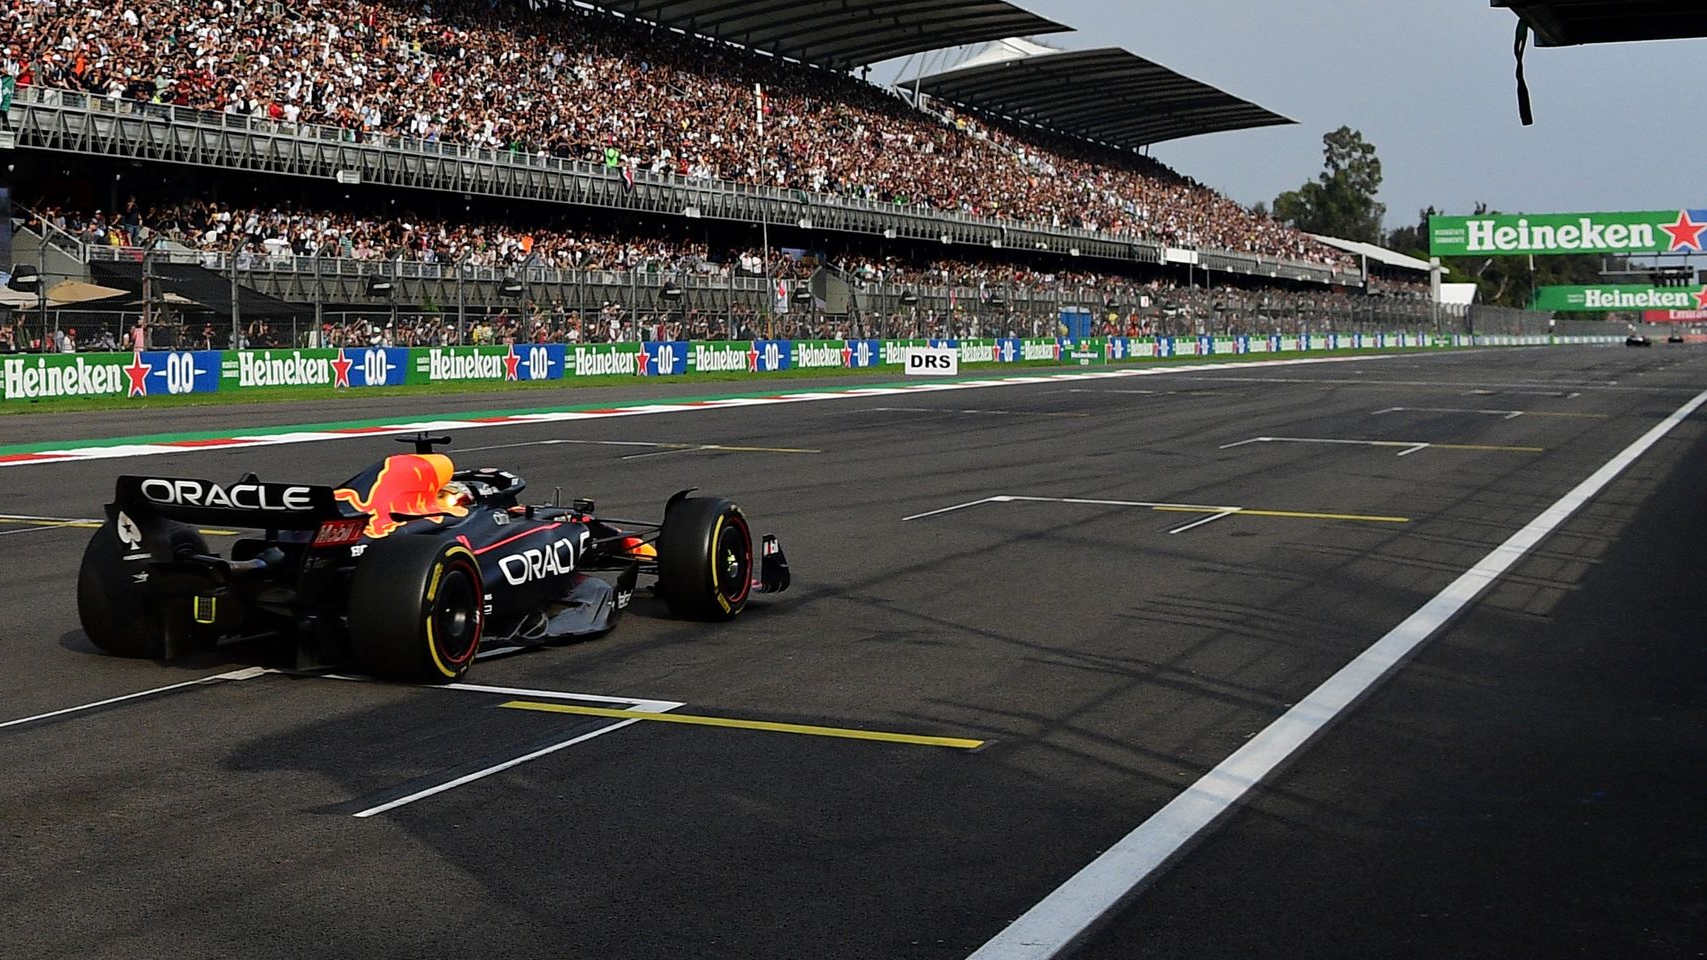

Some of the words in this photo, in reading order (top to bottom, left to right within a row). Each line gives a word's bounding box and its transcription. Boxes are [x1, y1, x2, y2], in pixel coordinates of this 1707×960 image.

[1466, 218, 1655, 251] Heineken
[1584, 289, 1689, 307] Heineken
[238, 350, 330, 386] Heineken
[365, 349, 387, 386] 0.0
[429, 349, 502, 380] Heineken
[575, 347, 635, 376] Heineken
[696, 345, 746, 371] Heineken
[798, 344, 841, 369] Heineken
[911, 355, 950, 368] DRS
[4, 357, 123, 398] Heineken
[167, 352, 193, 394] 0.0
[141, 479, 313, 510] ORACLE
[315, 524, 352, 543] Mobil
